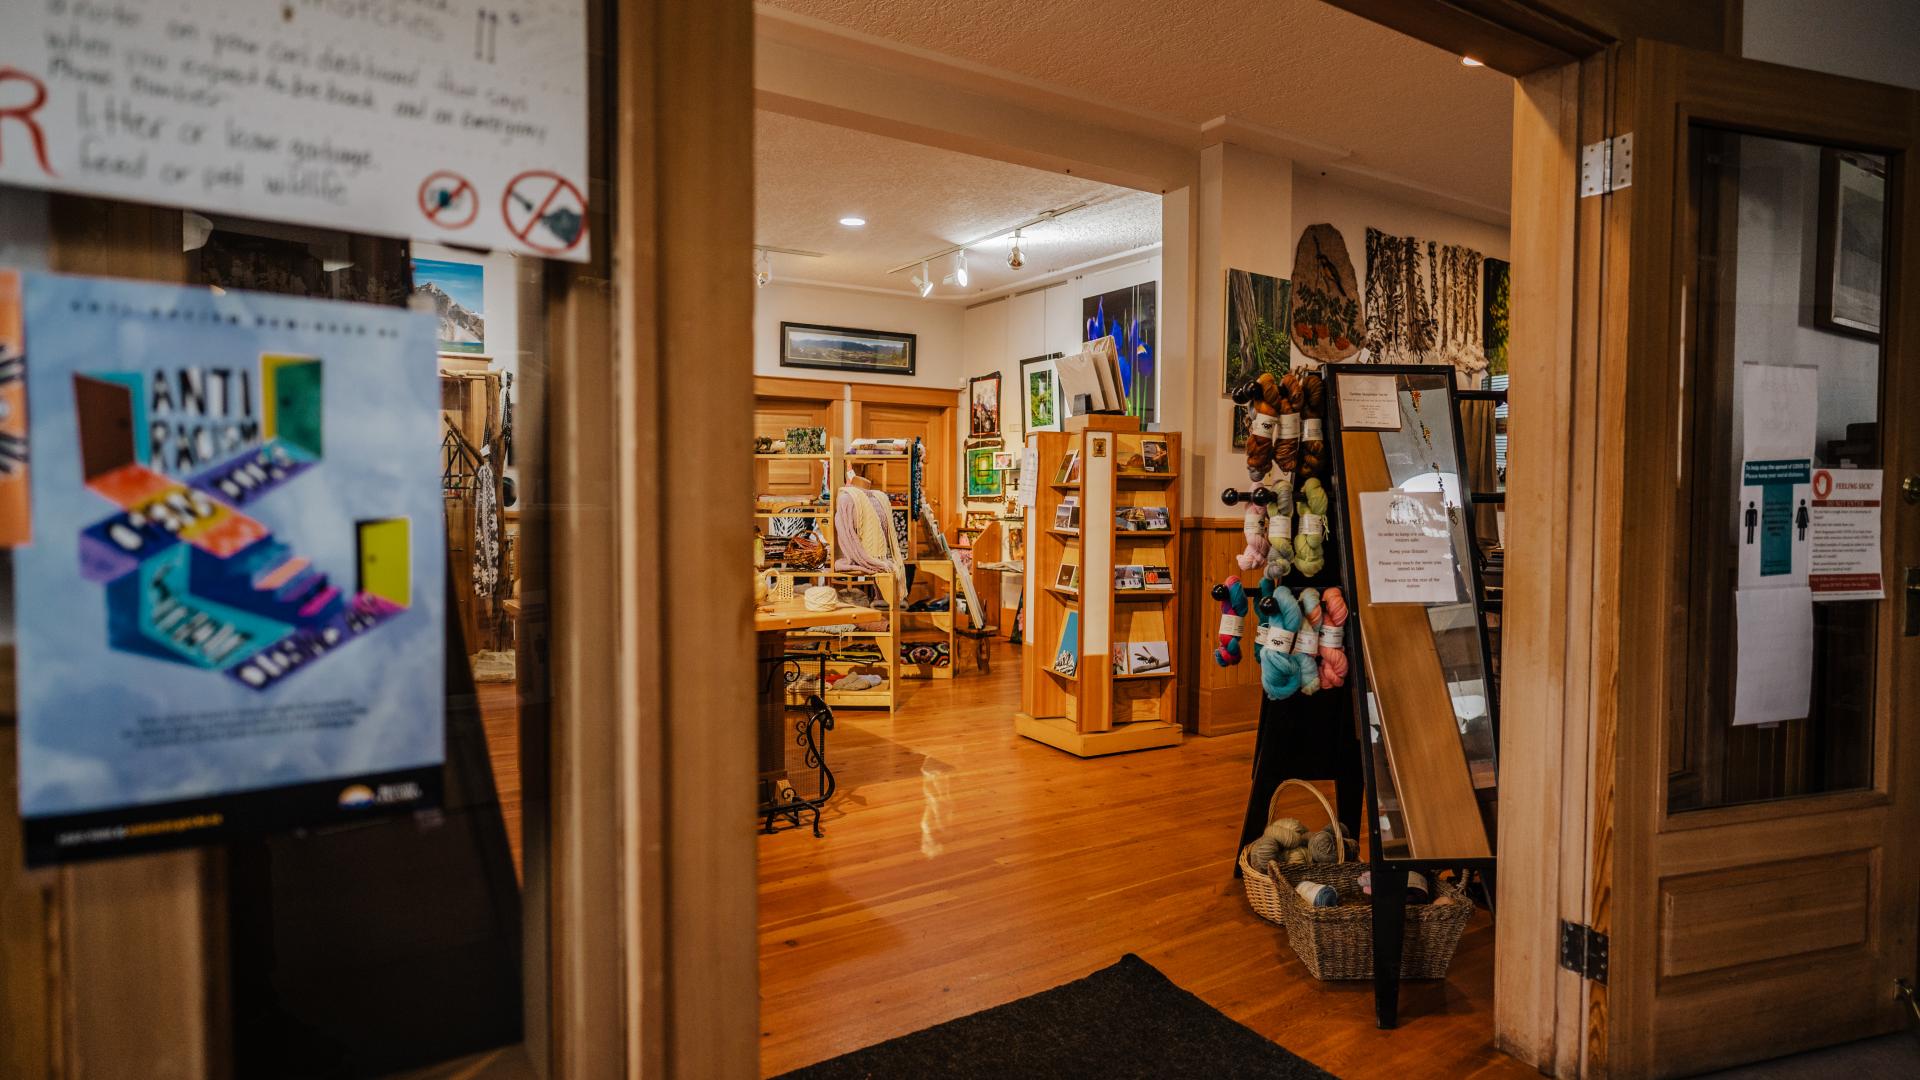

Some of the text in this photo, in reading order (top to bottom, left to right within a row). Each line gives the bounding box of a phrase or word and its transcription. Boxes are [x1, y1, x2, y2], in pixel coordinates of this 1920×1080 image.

[176, 120, 209, 145] or
[158, 161, 191, 188] or
[150, 366, 253, 420] ANTI
[149, 418, 261, 476] RACISM
[1836, 482, 1857, 490] FEELING
